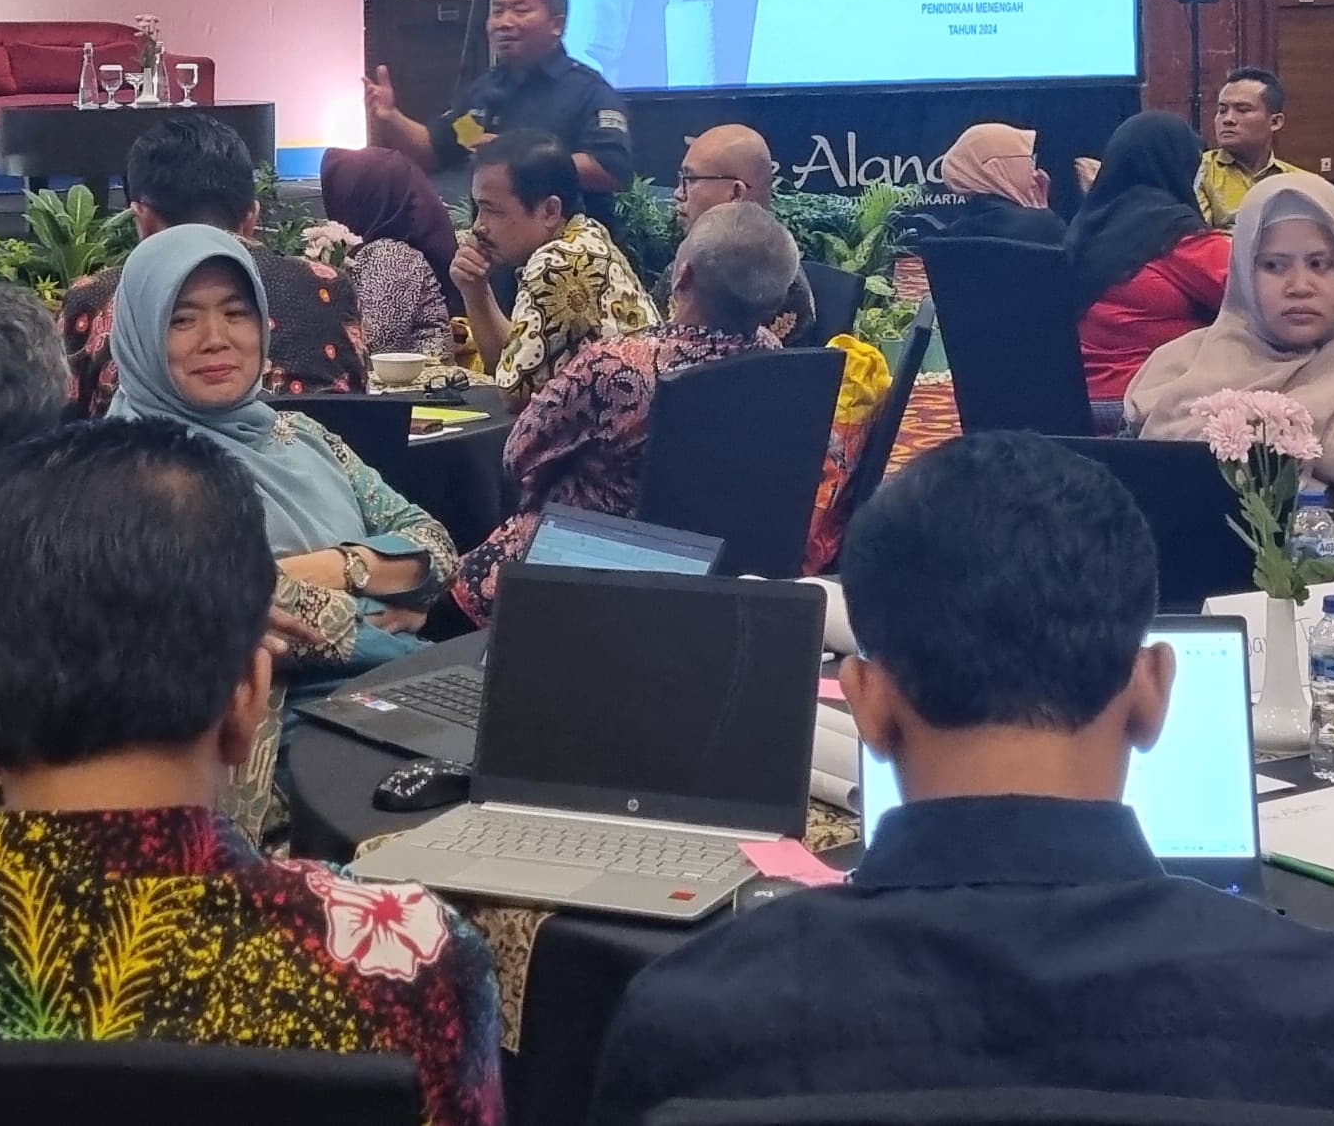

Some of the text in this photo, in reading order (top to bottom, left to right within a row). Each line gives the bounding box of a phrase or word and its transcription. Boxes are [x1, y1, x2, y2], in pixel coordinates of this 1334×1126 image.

[921, 1, 1024, 15] PENDIDIKAN MENENGAH
[948, 23, 998, 36] TAHUN 2024
